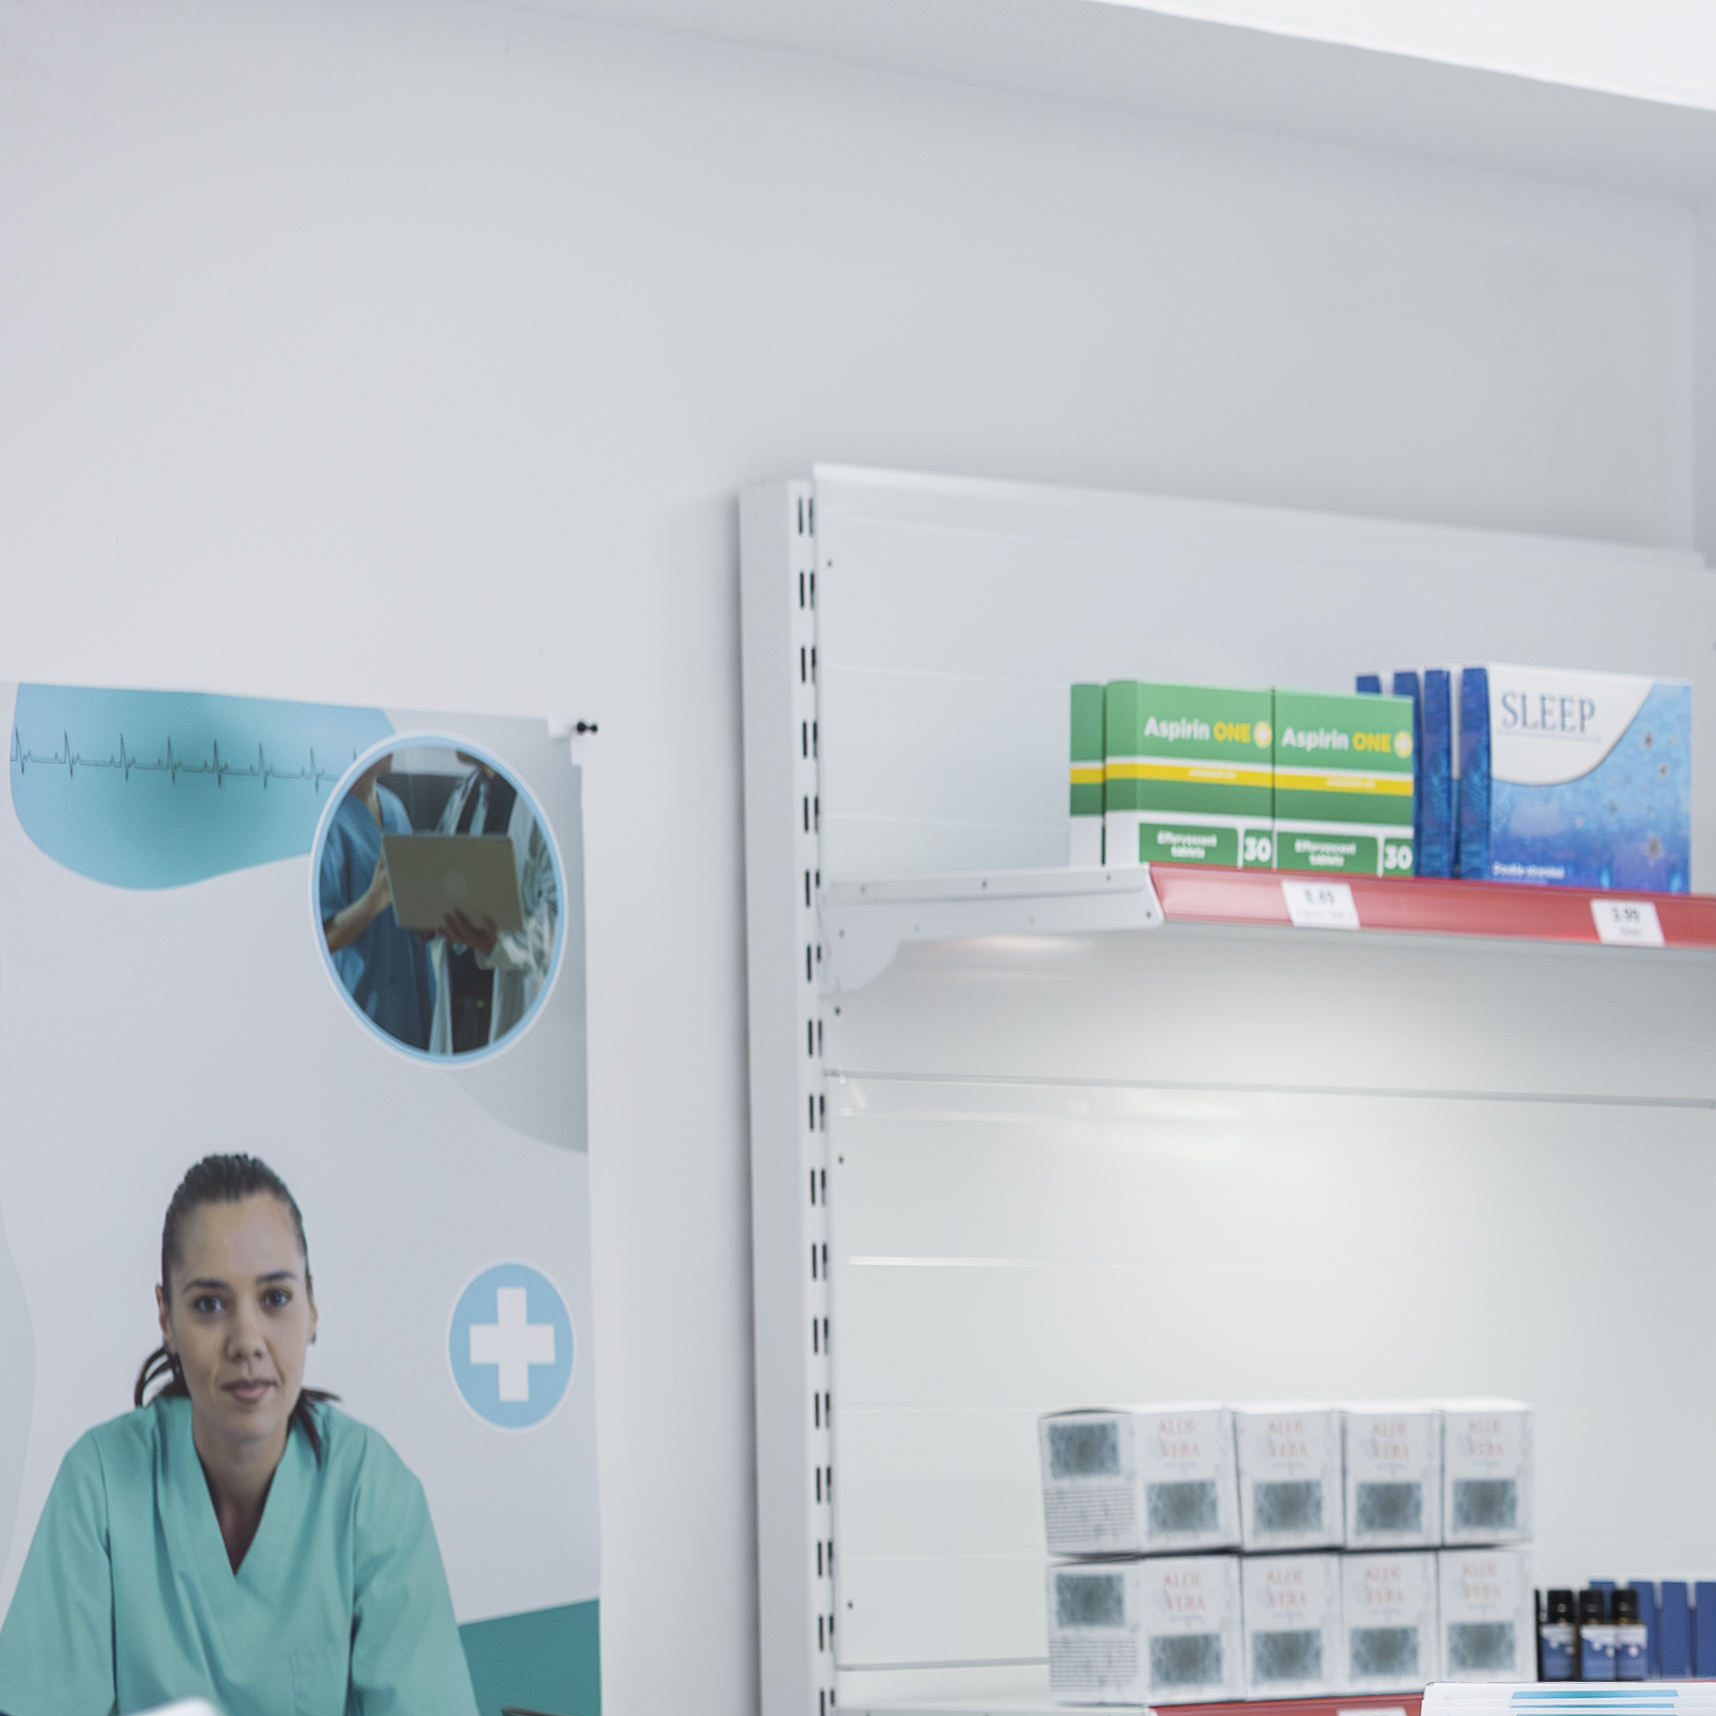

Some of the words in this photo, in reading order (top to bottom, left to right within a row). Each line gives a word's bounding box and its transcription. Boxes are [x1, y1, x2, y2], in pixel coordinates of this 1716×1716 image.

[1501, 690, 1595, 734] SLEEP
[1145, 716, 1210, 741] Aspirin
[1213, 721, 1251, 743] ONE
[1282, 726, 1348, 752] Aspirin
[1353, 732, 1392, 753] ONE
[1244, 837, 1271, 862] 30
[1385, 845, 1413, 870] 30
